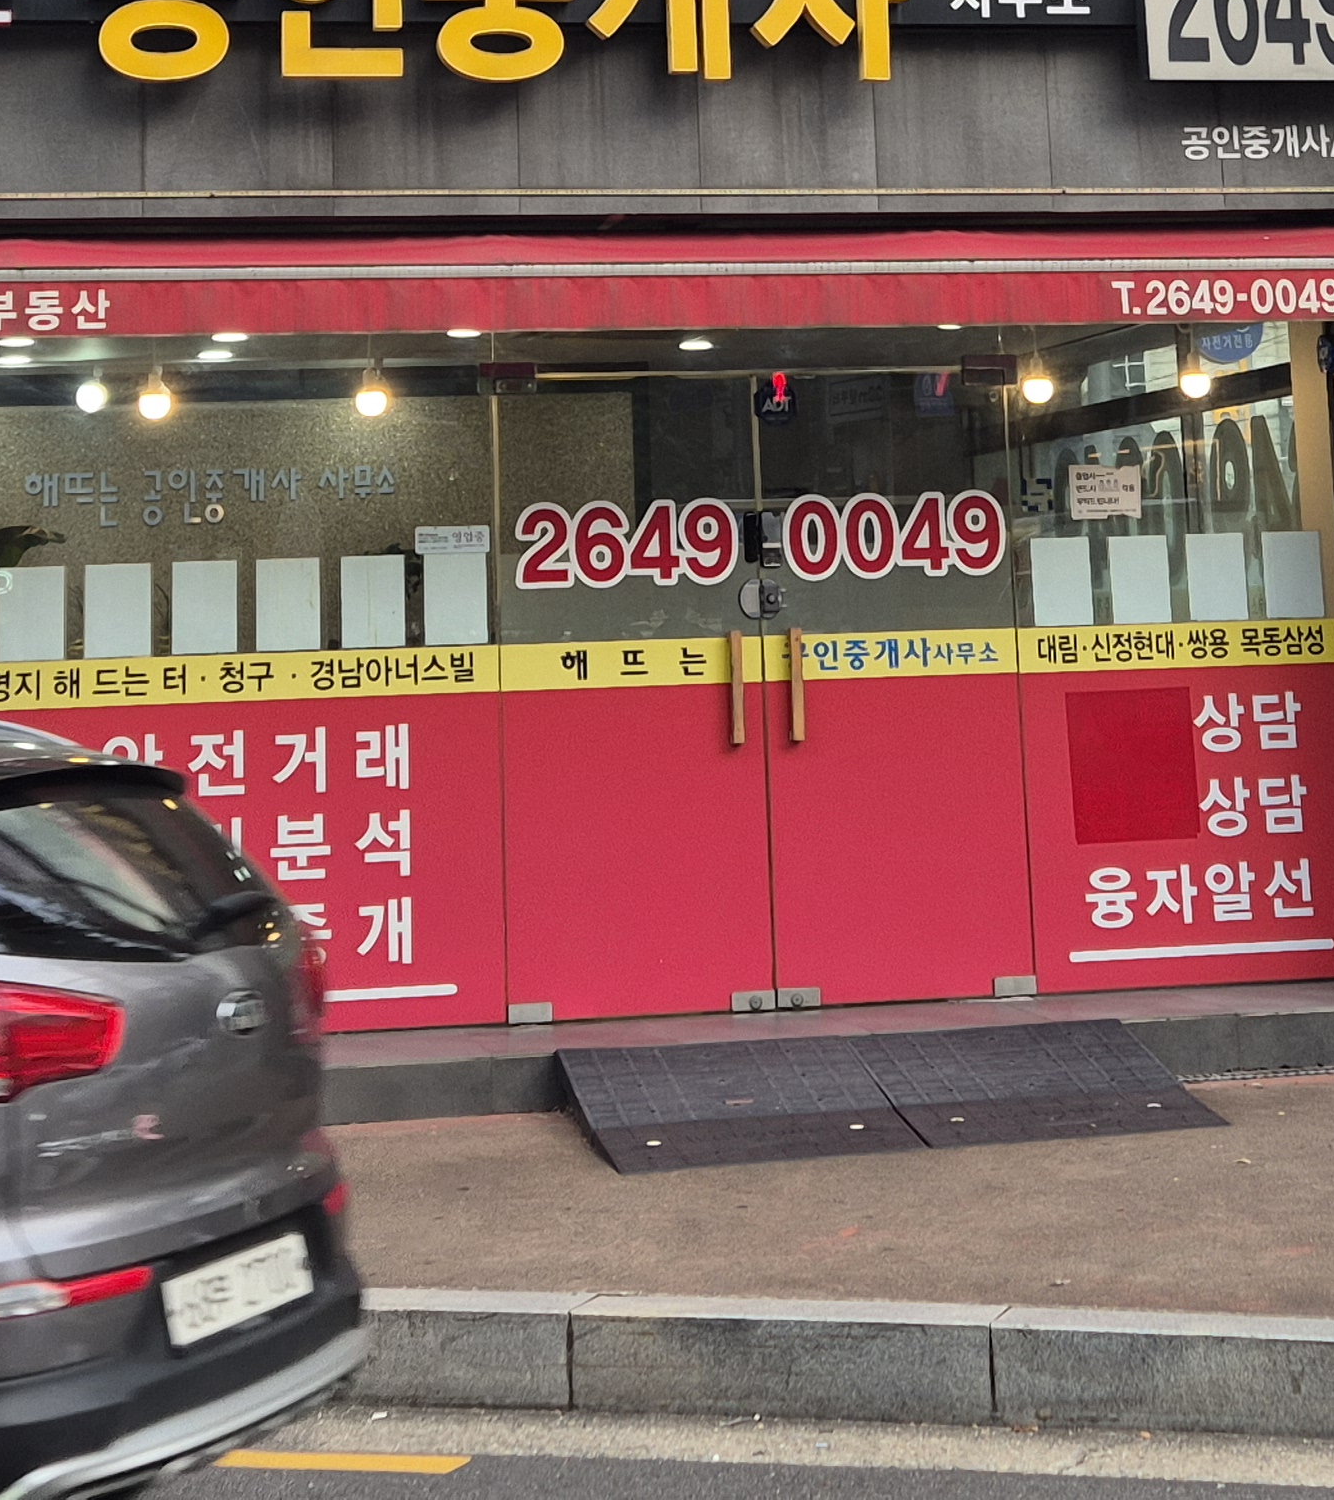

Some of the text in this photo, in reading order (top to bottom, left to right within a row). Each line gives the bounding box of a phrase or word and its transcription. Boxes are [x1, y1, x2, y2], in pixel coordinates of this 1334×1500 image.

[24, 464, 397, 528] 해뜨는 공인중개사 사무소
[515, 490, 1007, 589] 2649 0049
[219, 660, 275, 694] 청구
[309, 651, 476, 691] 경남아너스빌
[1240, 624, 1326, 657] 목동삼성
[1193, 690, 1302, 753] 상담
[1198, 773, 1308, 838] 상담
[1084, 857, 1315, 929] 융자알선
